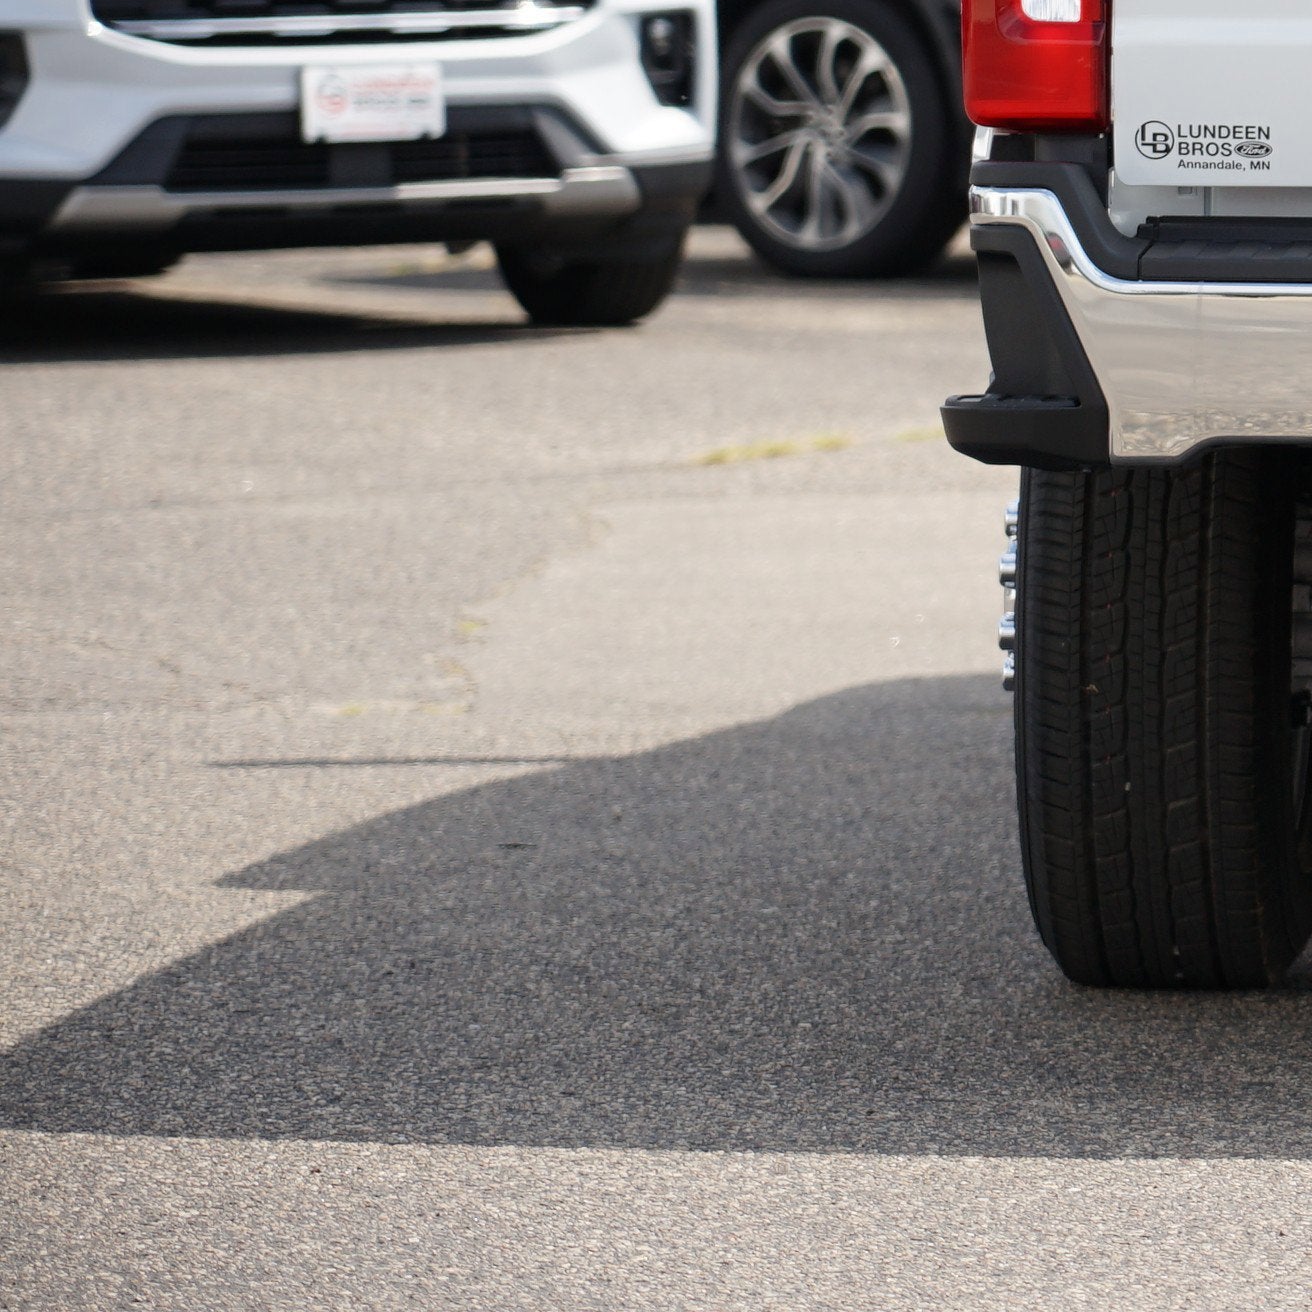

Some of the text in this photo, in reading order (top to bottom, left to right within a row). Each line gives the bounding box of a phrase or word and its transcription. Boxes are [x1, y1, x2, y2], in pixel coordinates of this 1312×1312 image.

[1177, 124, 1271, 141] LUNDEEN
[1177, 142, 1233, 157] BROS
[1177, 159, 1271, 171] Annandale, MN
